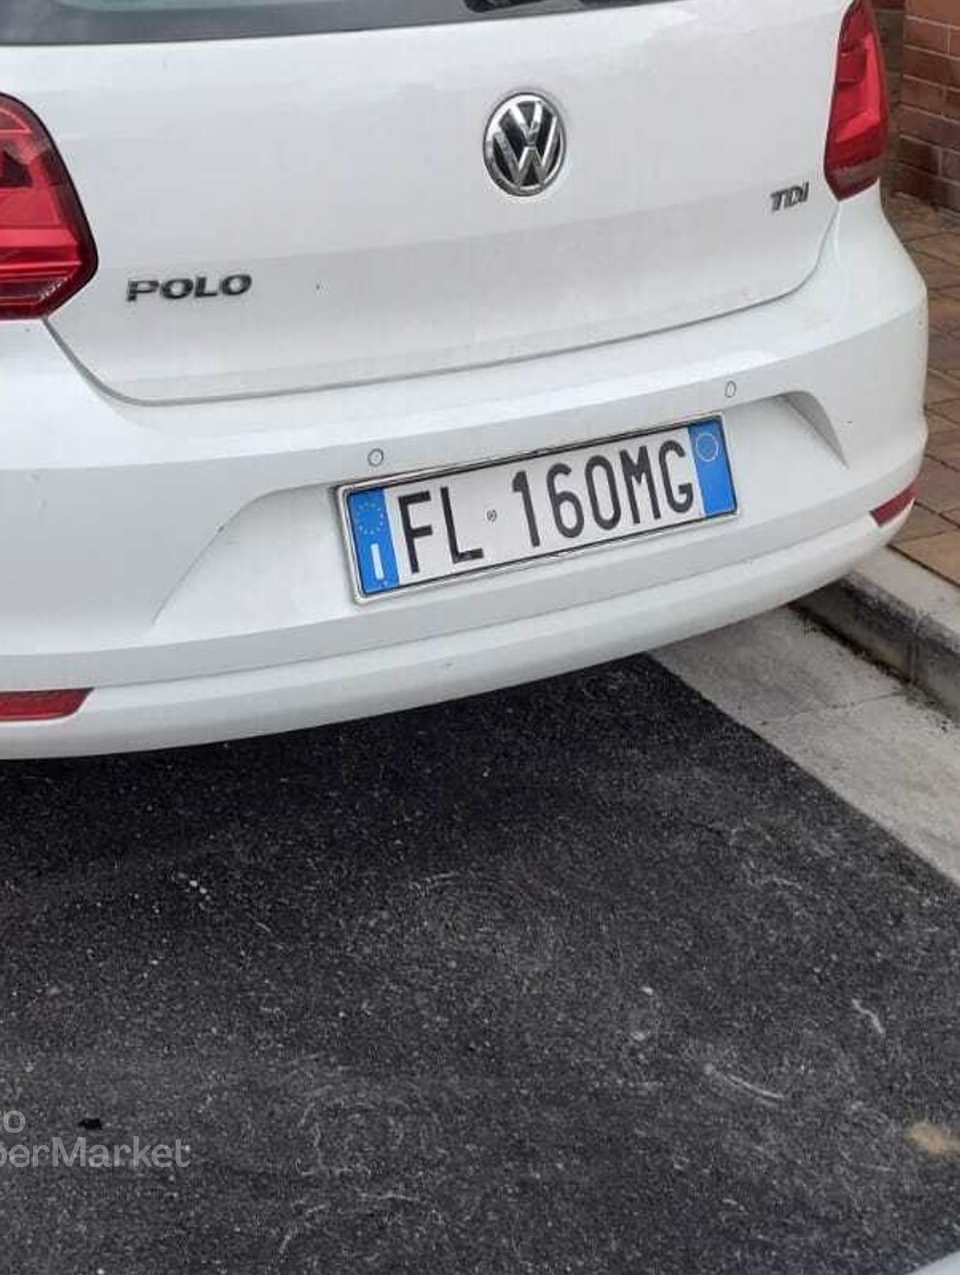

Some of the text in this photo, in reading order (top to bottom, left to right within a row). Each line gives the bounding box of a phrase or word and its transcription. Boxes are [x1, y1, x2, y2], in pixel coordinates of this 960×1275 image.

[770, 182, 809, 212] TDI
[127, 274, 252, 302] POLO
[397, 487, 483, 574] FL
[511, 440, 695, 548] 160MG
